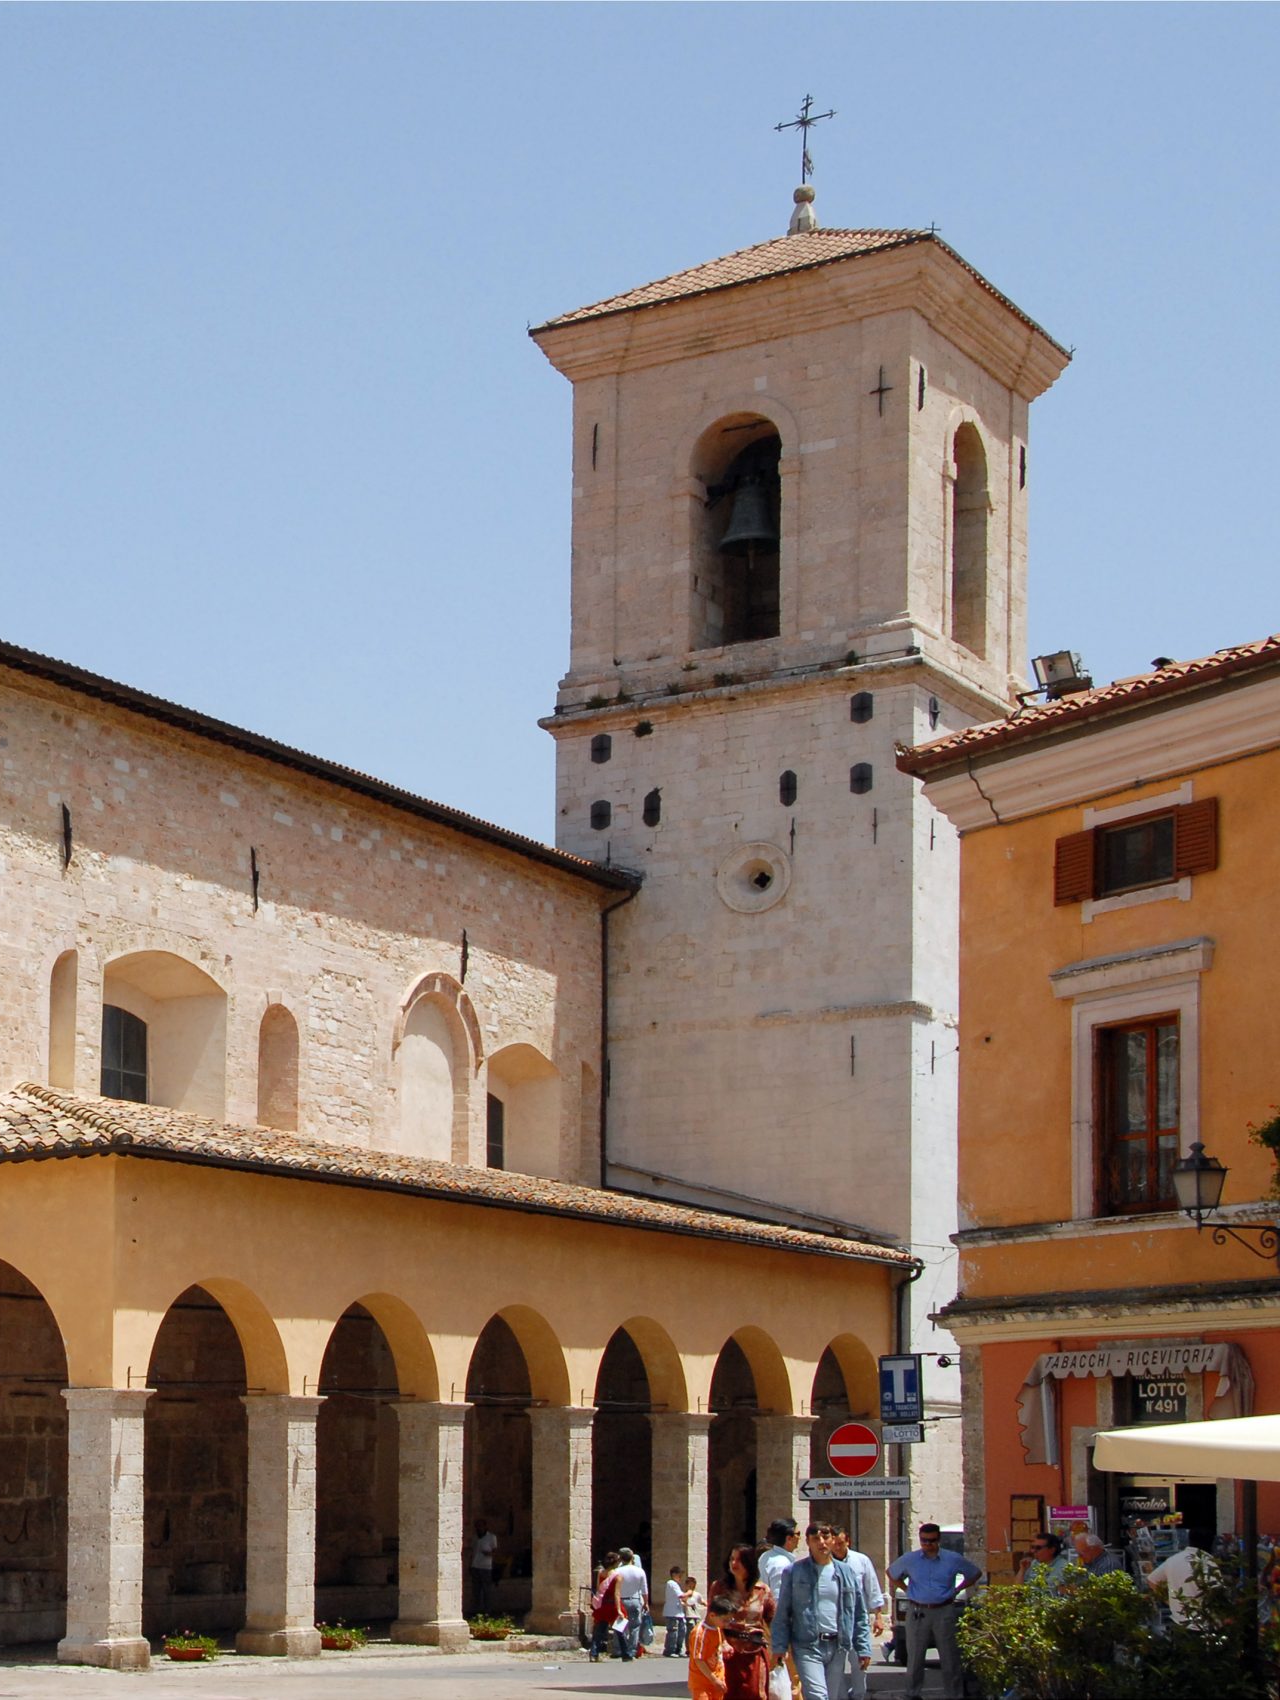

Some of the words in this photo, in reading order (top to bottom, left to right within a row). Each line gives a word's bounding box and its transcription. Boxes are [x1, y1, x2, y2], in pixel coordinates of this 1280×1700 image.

[1045, 1353, 1110, 1368] TABACCHI
[1127, 1348, 1214, 1366] RICEVITORIA
[882, 1360, 915, 1403] T
[1139, 1382, 1187, 1397] LOTTO
[1154, 1399, 1178, 1413] 491
